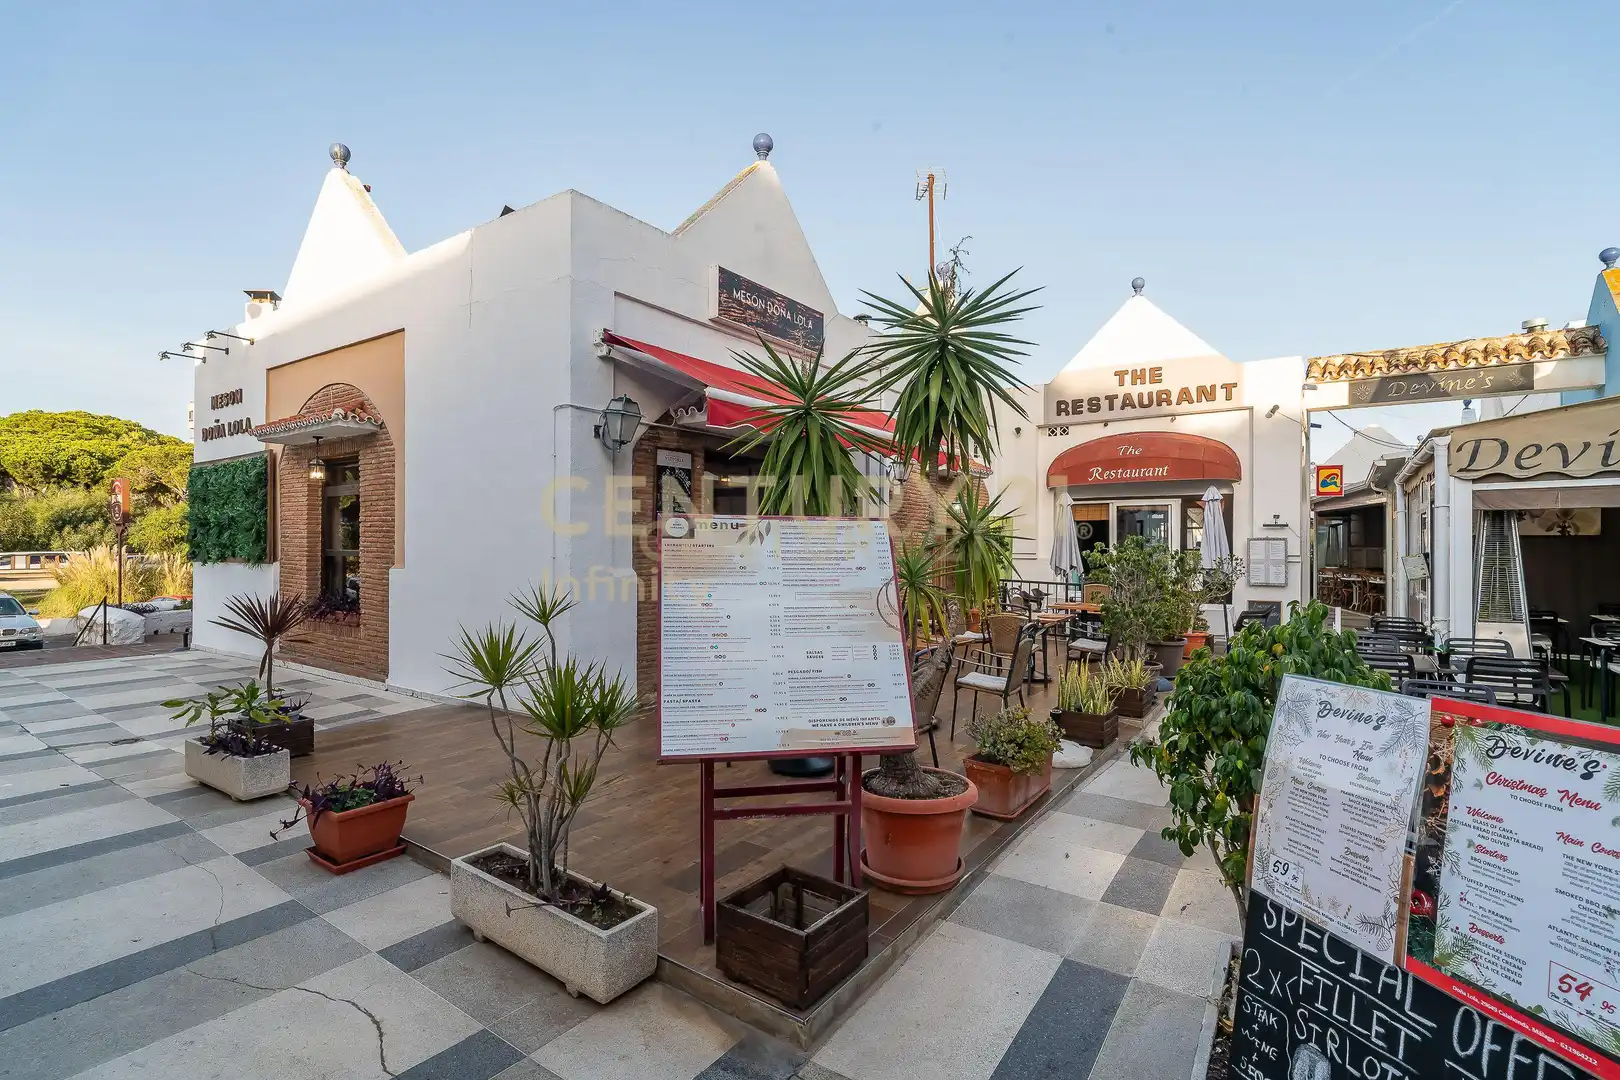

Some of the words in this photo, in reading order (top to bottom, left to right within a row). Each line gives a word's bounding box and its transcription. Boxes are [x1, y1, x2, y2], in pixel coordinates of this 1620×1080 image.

[733, 287, 765, 309] MESÓN
[793, 312, 813, 330] LOLA
[1114, 366, 1163, 388] THE
[1387, 370, 1496, 398] Devine's
[1056, 382, 1238, 417] RESTAURANT
[202, 418, 227, 442] DOÑA
[228, 417, 252, 437] LOLA
[1117, 445, 1143, 456] The
[1087, 464, 1170, 481] Restaurant
[695, 521, 739, 530] menu
[1317, 700, 1387, 731] Devine's
[1327, 756, 1350, 768] CHOOSE
[1351, 762, 1369, 773] FROM
[1485, 771, 1548, 798] Christmas
[1557, 788, 1602, 811] Menu
[1465, 805, 1504, 824] Welcome
[1518, 796, 1543, 808] CHOOSE
[1544, 803, 1564, 813] FROM
[1449, 817, 1472, 829] ARTISAN
[1472, 824, 1491, 836] BREAD
[1491, 830, 1520, 844] (CIABATTA
[1520, 840, 1544, 853] BREAD)
[1472, 818, 1489, 828] GLASS
[1498, 826, 1514, 836] CAVA
[1477, 833, 1490, 842] AND
[1490, 837, 1510, 848] OLIVES
[1555, 831, 1585, 848] Main
[1474, 844, 1508, 862] Starters
[1562, 852, 1575, 861] THE
[1575, 857, 1593, 867] NEW
[1594, 862, 1613, 874] YORK
[1470, 855, 1482, 864] BBQ
[1482, 860, 1502, 871] ONION
[1502, 866, 1519, 877] SOUP
[1460, 874, 1484, 888] STUFFED
[1484, 884, 1506, 897] POTATO
[1507, 891, 1525, 903] SKINS
[1554, 887, 1584, 902] SMOKED
[1585, 898, 1600, 909] BBQ
[1466, 900, 1475, 908] PIL
[1478, 905, 1487, 913] PIL
[1487, 909, 1513, 923] PRAWNS
[1577, 903, 1609, 919] CHICKEN
[1468, 921, 1505, 945] Desserts
[1547, 924, 1580, 941] ATLANTIC
[1580, 936, 1612, 954] SALMON
[1548, 940, 1563, 950] with
[1563, 945, 1579, 957] baby
[1556, 935, 1577, 948] Grilled
[1577, 944, 1602, 958] salmon
[1263, 899, 1438, 1029] SPECIAL
[1484, 956, 1499, 968] CAKE
[1499, 963, 1523, 979] SERVED
[1491, 953, 1501, 962] ICE
[1501, 957, 1523, 972] CREAM
[1504, 951, 1527, 966] SERVED
[1490, 967, 1500, 976] ICE
[1500, 972, 1522, 987] CREAM
[1242, 994, 1279, 1030] STEAK
[1299, 959, 1422, 1062] FILLET
[1241, 1027, 1279, 1061] WINE
[1294, 1008, 1411, 1080] SIRLO
[1498, 1009, 1531, 1031] Calahonda,
[1559, 1042, 1598, 1067] 611964212
